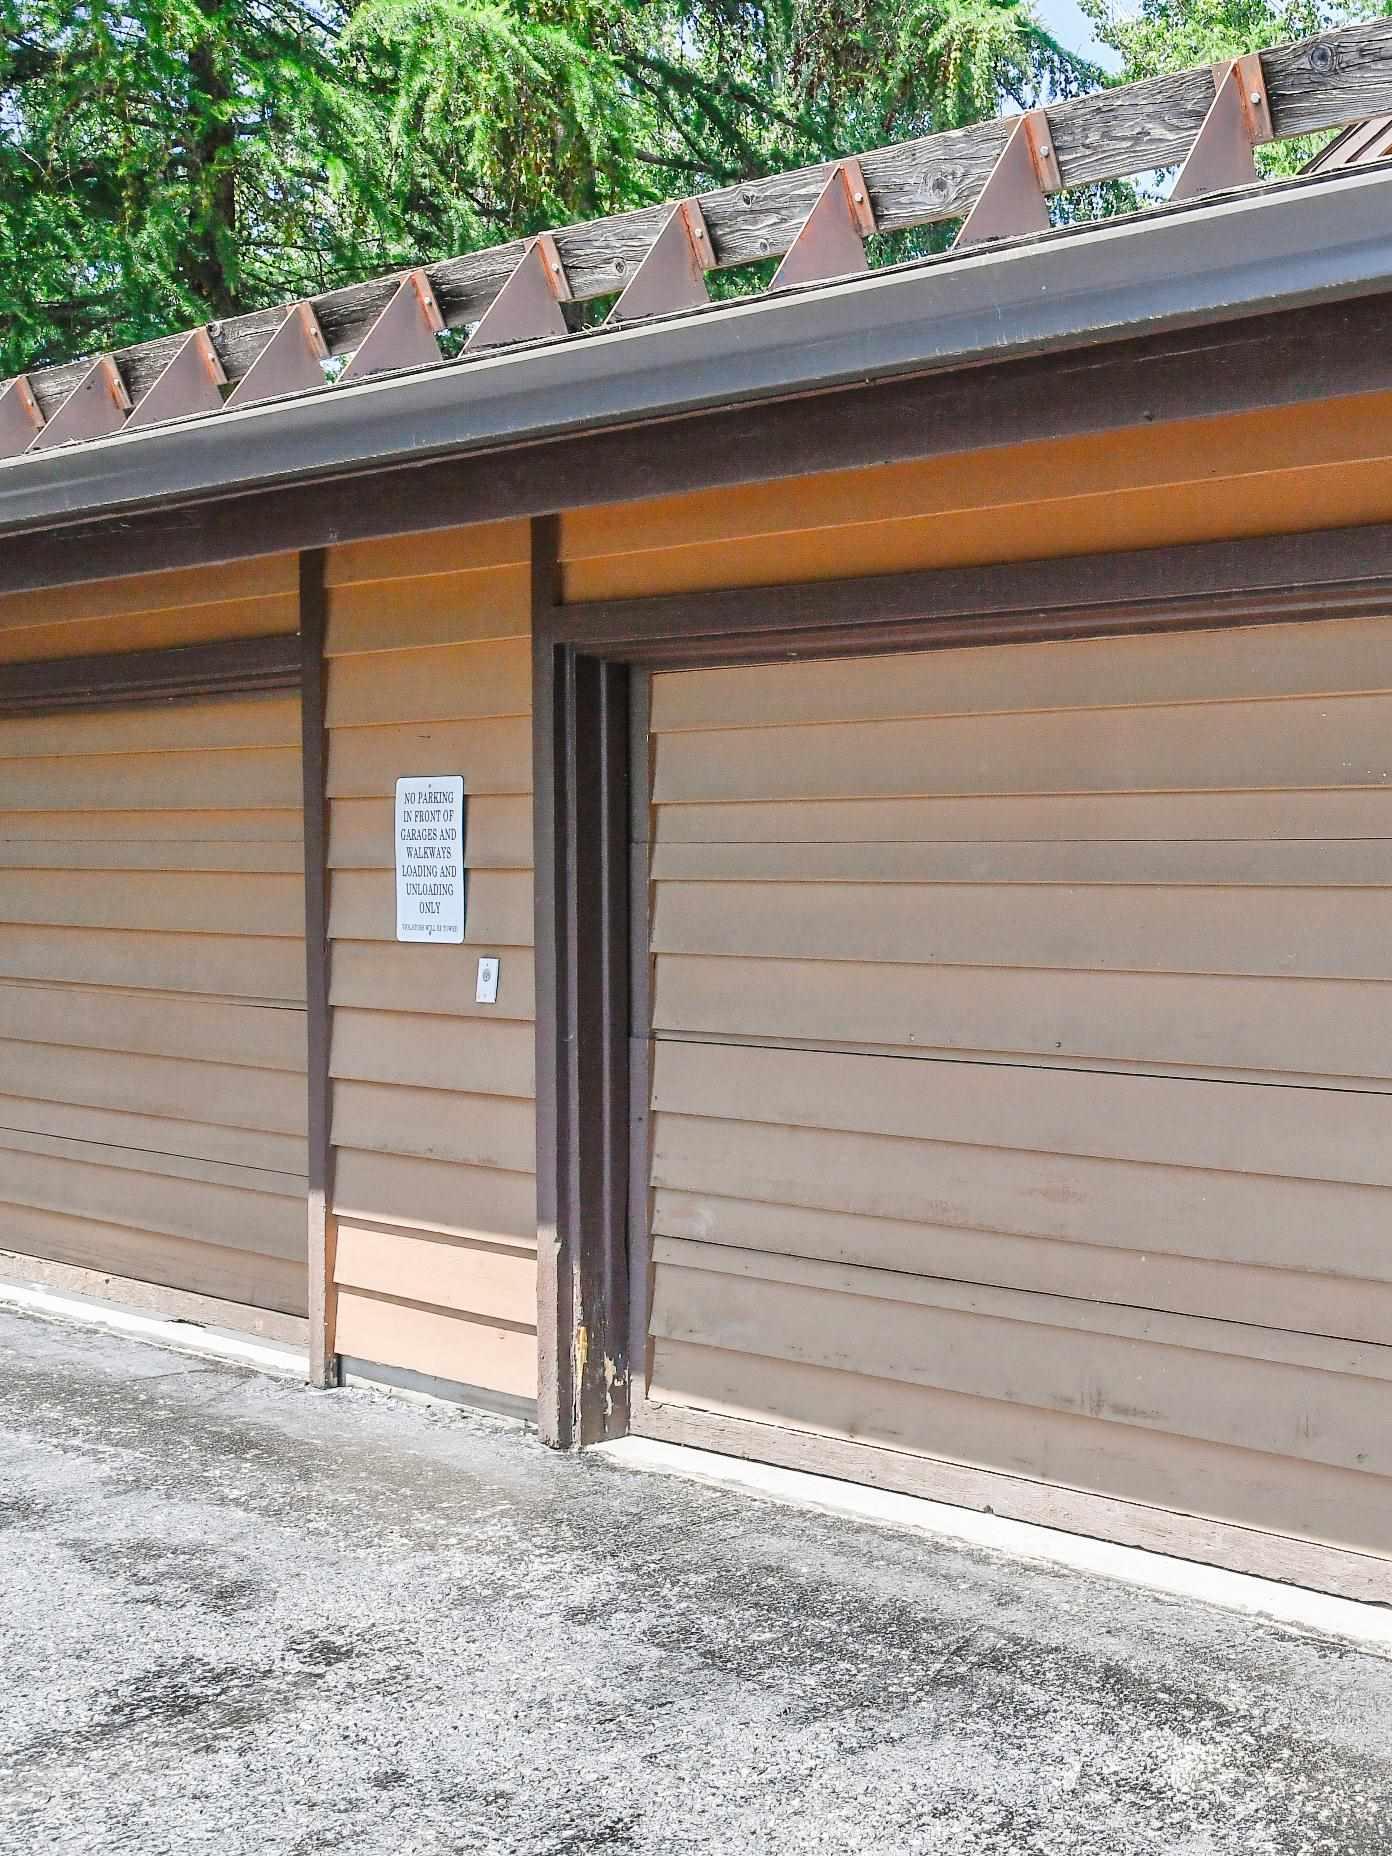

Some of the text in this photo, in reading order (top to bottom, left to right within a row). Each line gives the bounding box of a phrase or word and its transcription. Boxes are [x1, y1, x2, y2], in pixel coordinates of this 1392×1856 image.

[404, 791, 454, 805] NO PARKING
[403, 809, 455, 823] IN FRONT OF
[400, 828, 457, 841] GARAGES AND
[406, 846, 452, 859] WALKWAYS
[401, 864, 457, 877] LOADING AND
[406, 883, 454, 896] UNLOADING
[419, 901, 441, 914] ONLY
